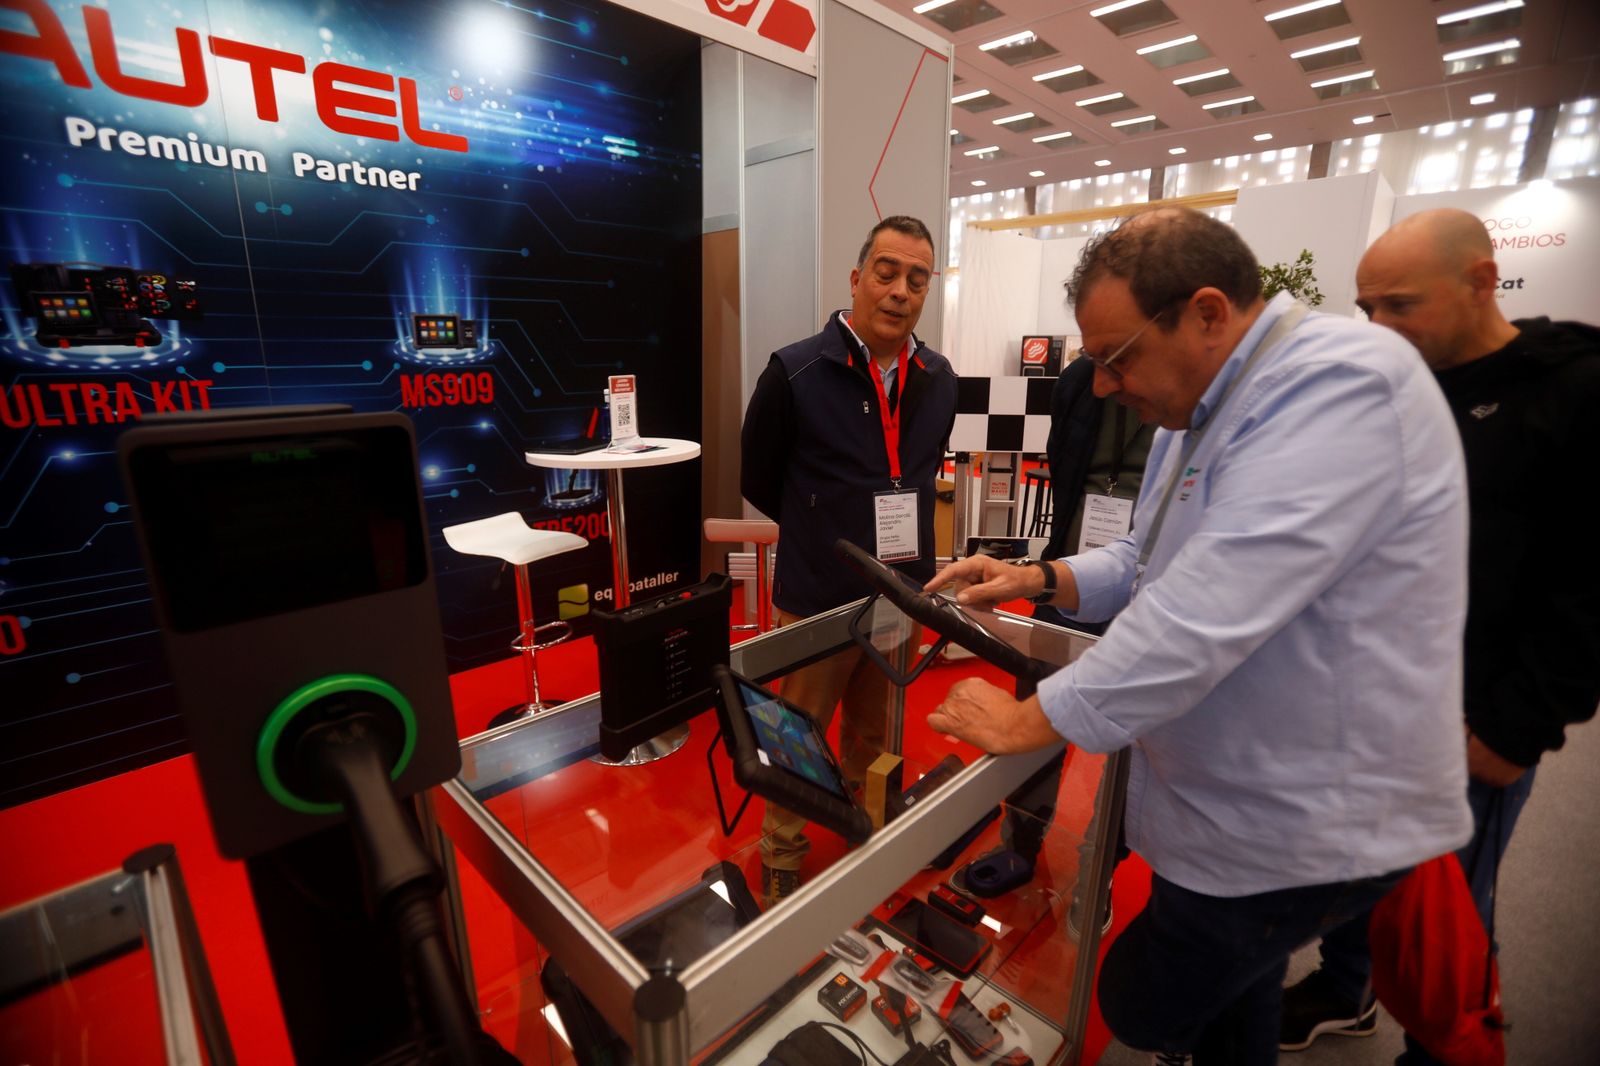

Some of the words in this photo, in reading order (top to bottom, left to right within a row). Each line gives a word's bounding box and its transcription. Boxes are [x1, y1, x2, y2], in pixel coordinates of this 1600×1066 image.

[0, 0, 469, 153] AUTEL
[64, 116, 268, 174] Premium
[293, 151, 421, 191] Partner
[0, 381, 142, 429] ULTRA
[150, 379, 214, 414] KIT
[399, 371, 495, 408] MS909
